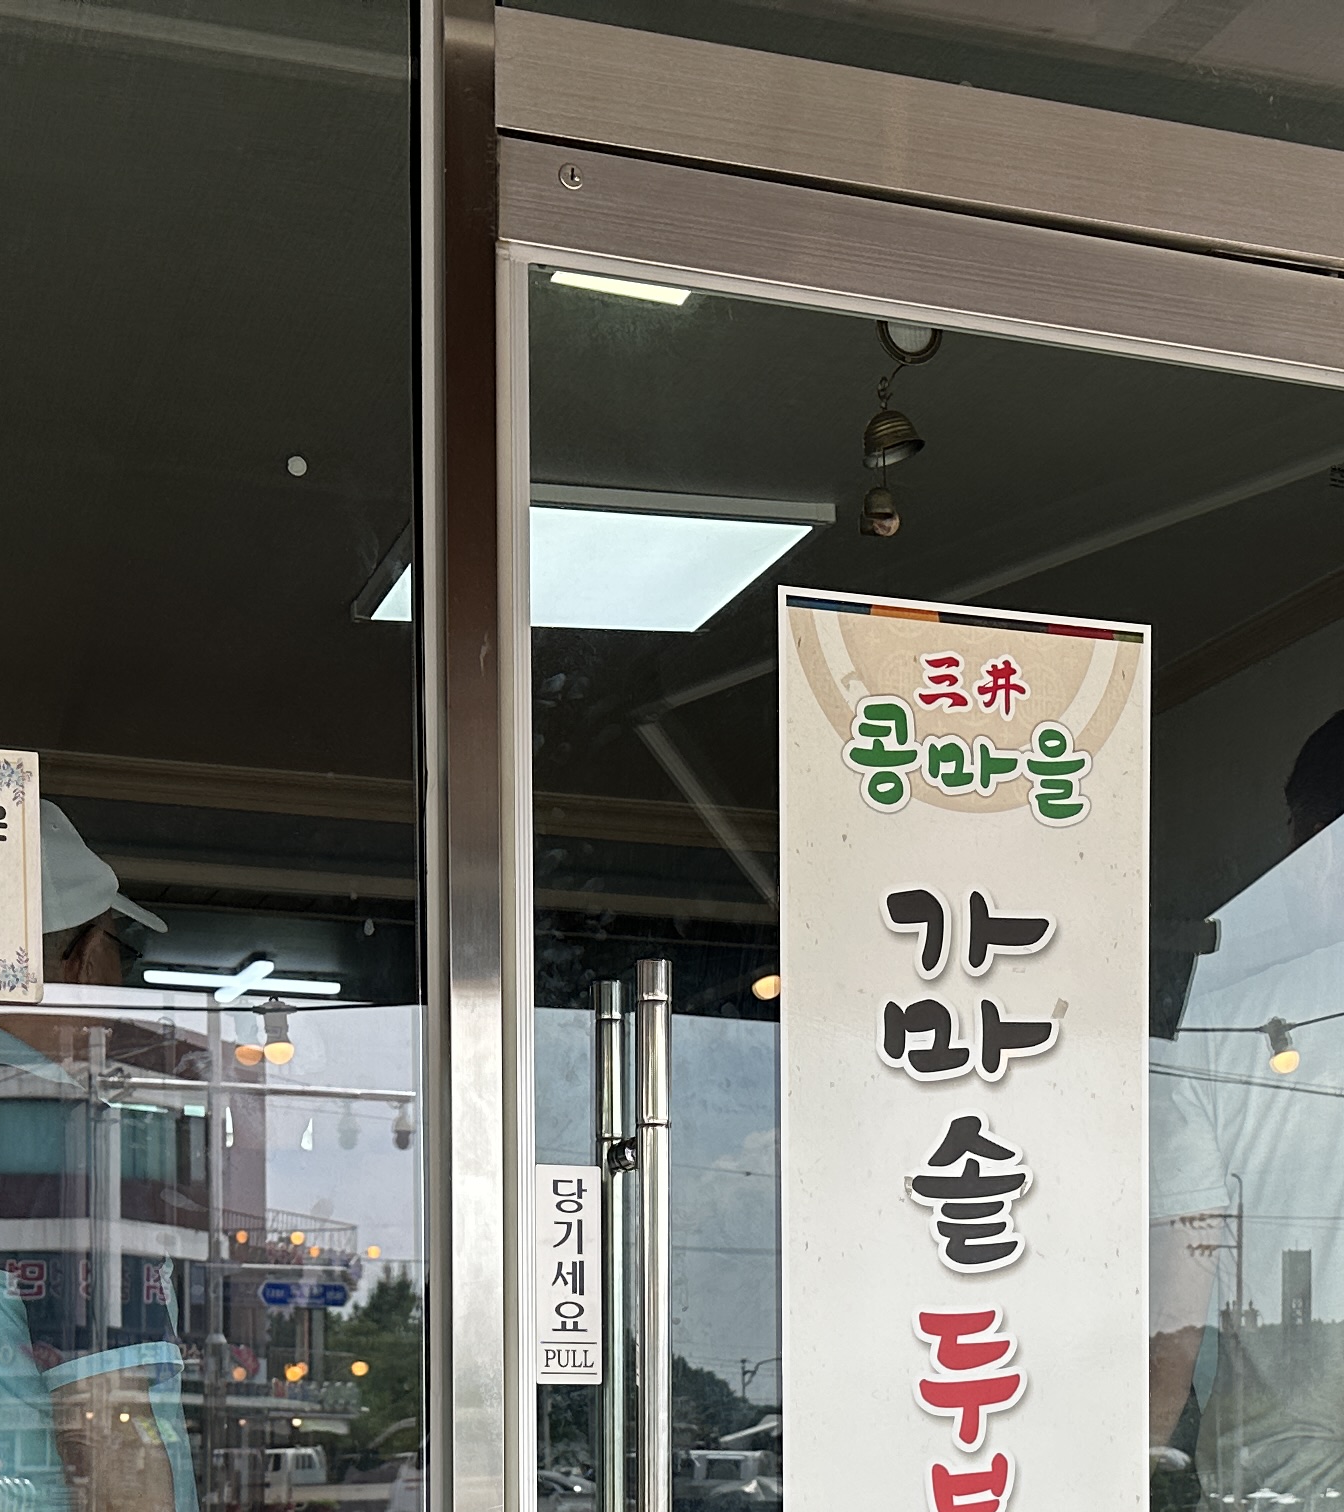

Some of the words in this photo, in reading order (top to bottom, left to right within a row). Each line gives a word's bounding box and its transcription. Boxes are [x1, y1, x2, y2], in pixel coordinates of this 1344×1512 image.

[918, 656, 1026, 716] 三井
[849, 701, 1086, 819] 콩마을
[551, 1178, 589, 1333] 당기세요
[543, 1348, 595, 1369] PULL
